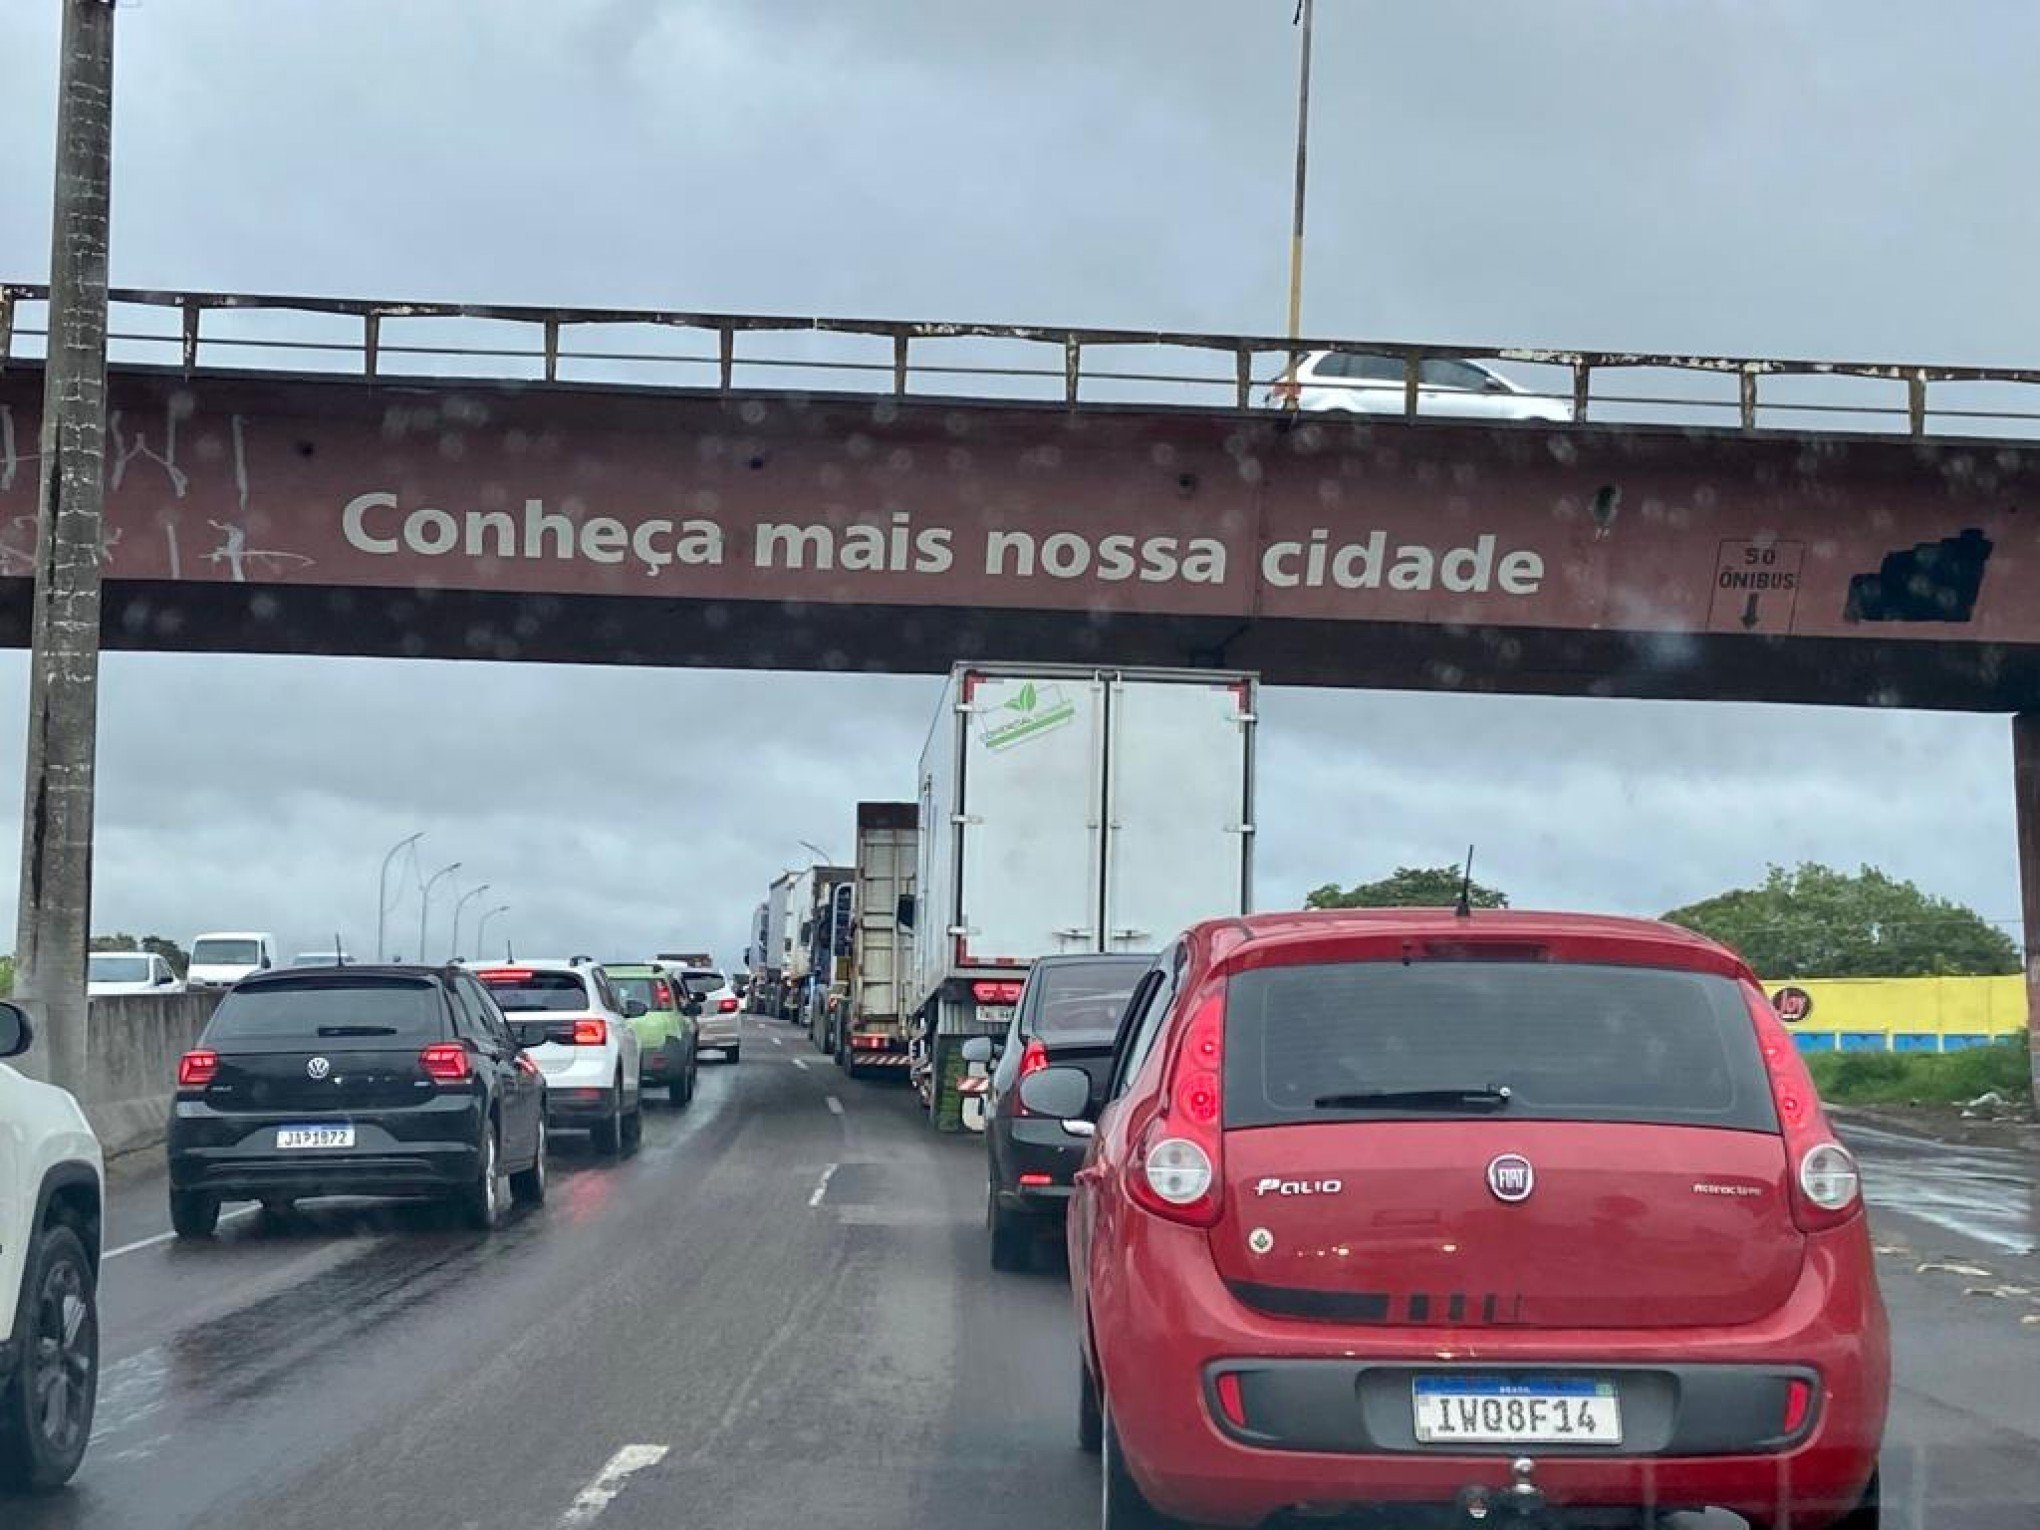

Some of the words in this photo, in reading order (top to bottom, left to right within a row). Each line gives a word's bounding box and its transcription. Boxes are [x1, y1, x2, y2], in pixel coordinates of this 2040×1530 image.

[342, 491, 723, 577] Conheça
[754, 511, 954, 573] mais
[984, 529, 1227, 584] nossa
[1261, 529, 1545, 594] cidade
[1499, 1168, 1524, 1188] FIAT
